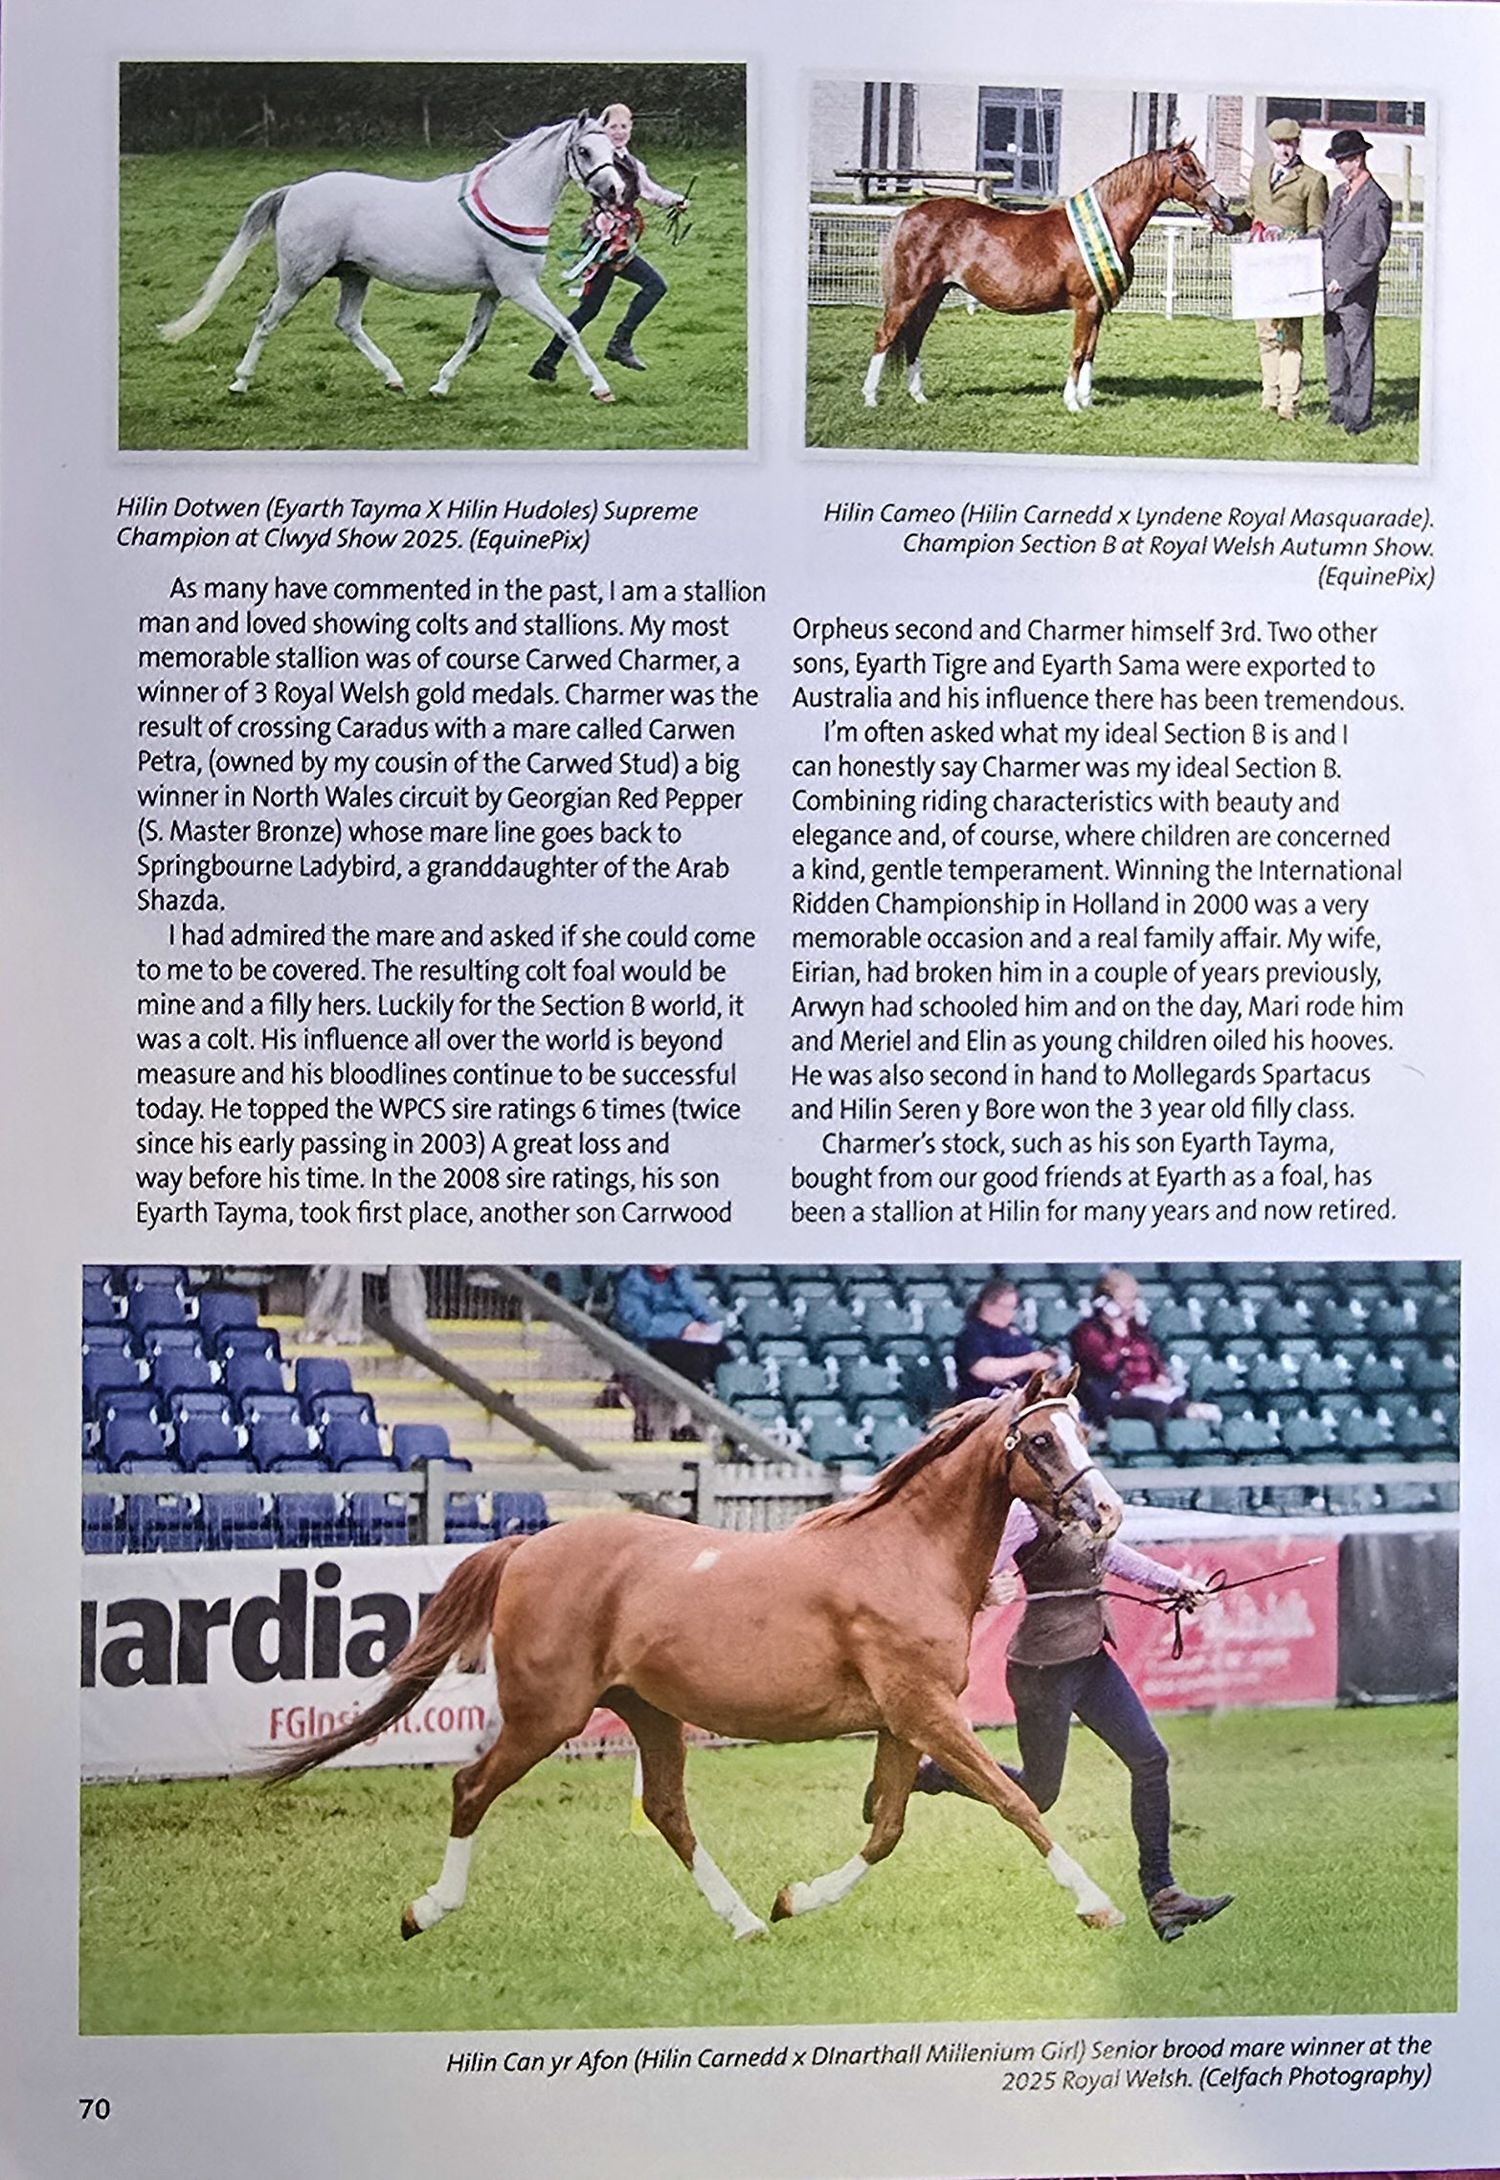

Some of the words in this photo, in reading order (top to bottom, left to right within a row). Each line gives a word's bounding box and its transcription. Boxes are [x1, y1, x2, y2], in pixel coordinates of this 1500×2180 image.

[117, 496, 168, 517] Hilin
[174, 497, 261, 518] Dotwen
[266, 496, 345, 525] (Eyarth
[351, 498, 422, 526] Tayma
[425, 499, 444, 520] X
[447, 499, 498, 520] Hilin
[503, 499, 599, 526] Hudoles)
[604, 500, 699, 527] Supreme
[824, 502, 874, 522] Hilin
[880, 503, 956, 524] Cameo
[961, 502, 1018, 528] (Hilin
[1024, 505, 1114, 525] Carnedd
[1117, 510, 1132, 525] x
[1136, 506, 1223, 532] Lyndene
[1228, 507, 1286, 534] Royal
[1290, 507, 1434, 533] Masquarade).
[117, 525, 230, 554] Champion
[235, 528, 260, 548] at
[264, 527, 333, 555] Clwyd
[337, 527, 399, 549] Show
[402, 529, 463, 550] 2025.
[470, 527, 591, 556] (EquinePix)
[904, 532, 1015, 559] Champion
[1020, 534, 1097, 555] Section
[1103, 535, 1117, 555] B
[1121, 536, 1145, 555] at
[1150, 535, 1209, 562] Royal
[1214, 536, 1275, 556] Welsh
[1280, 537, 1368, 557] Autumn
[1373, 537, 1434, 558] Show.
[169, 577, 198, 599] As
[204, 581, 269, 608] many
[275, 576, 328, 600] have
[334, 577, 471, 601] commented
[478, 578, 499, 601] in
[504, 578, 543, 602] the
[549, 580, 604, 609] past,
[610, 580, 615, 601] I
[622, 585, 658, 602] am
[664, 585, 677, 602] a
[684, 579, 766, 603] stallion
[1319, 564, 1435, 592] (EquinePix)
[793, 616, 889, 647] Orpheus
[895, 618, 973, 641] second
[979, 618, 1021, 641] and
[1028, 618, 1126, 642] Charmer
[1132, 619, 1216, 643] himself
[1221, 620, 1262, 643] 3rd.
[1267, 621, 1313, 644] Two
[1318, 621, 1378, 644] other
[139, 714, 203, 739] result
[208, 714, 235, 738] of
[237, 715, 332, 747] crossing
[337, 715, 429, 740] Caradus
[435, 716, 487, 740] with
[493, 722, 506, 740] a
[513, 722, 571, 740] mare
[576, 716, 643, 741] called
[649, 718, 735, 741] Carwen
[137, 783, 219, 808] winner
[225, 784, 246, 808] in
[253, 784, 319, 808] North
[325, 784, 394, 809] Wales
[399, 785, 470, 809] circuit
[476, 785, 503, 817] by
[507, 786, 611, 817] Georgian
[618, 786, 659, 810] Red
[666, 787, 744, 817] Pepper
[792, 788, 917, 820] Combining
[923, 789, 988, 820] riding
[993, 789, 1153, 813] characteristics
[1159, 790, 1209, 813] with
[1217, 790, 1293, 821] beauty
[1299, 790, 1339, 813] and
[137, 853, 294, 885] Springbourne
[300, 853, 403, 885] Ladybird,
[408, 860, 421, 878] a
[427, 854, 599, 886] granddaughter
[604, 854, 629, 879] of
[632, 855, 671, 879] the
[676, 856, 730, 879] Arab
[792, 863, 805, 880] a
[812, 857, 866, 884] kind,
[871, 857, 943, 888] gentle
[948, 859, 1110, 888] temperament.
[1115, 858, 1211, 888] Winning
[1216, 858, 1253, 881] the
[1260, 859, 1402, 882] International
[137, 887, 225, 912] Shazda.
[137, 1067, 236, 1085] measure
[242, 1061, 284, 1086] and
[292, 1061, 324, 1086] his
[331, 1061, 448, 1086] bloodlines
[453, 1062, 554, 1086] continue
[559, 1064, 583, 1086] to
[589, 1062, 617, 1086] be
[622, 1062, 736, 1086] successful
[792, 1065, 823, 1087] He
[828, 1069, 873, 1087] was
[879, 1063, 924, 1087] also
[930, 1063, 1007, 1087] second
[1015, 1063, 1034, 1086] in
[1041, 1062, 1097, 1086] hand
[1104, 1064, 1127, 1086] to
[1133, 1062, 1257, 1093] Mollegards
[1263, 1063, 1371, 1092] Spartacus
[137, 1200, 208, 1231] Eyarth
[214, 1201, 294, 1231] Tayma,
[299, 1200, 351, 1224] took
[356, 1200, 403, 1224] first
[409, 1200, 474, 1231] place,
[480, 1200, 571, 1224] another
[576, 1206, 616, 1224] son
[622, 1200, 732, 1224] Carrwood
[792, 1200, 846, 1223] been
[852, 1206, 865, 1223] a
[871, 1200, 953, 1223] stallion
[960, 1201, 983, 1223] at
[989, 1200, 1040, 1222] Hilin
[1046, 1198, 1078, 1222] for
[1084, 1205, 1147, 1229] many
[1151, 1204, 1210, 1229] years
[1216, 1198, 1257, 1221] and
[1265, 1204, 1313, 1221] now
[1319, 1198, 1396, 1221] retired.
[80, 1561, 486, 1688] ardia
[447, 2052, 498, 2073] Hilin
[504, 2052, 545, 2072] Can
[547, 2055, 574, 2078] yr
[576, 2049, 628, 2078] Afon
[634, 2048, 692, 2075] (Hilin
[698, 2046, 789, 2069] Carnedd
[792, 2051, 807, 2067] x
[926, 2042, 1035, 2064] Millenium
[1041, 2039, 1086, 2065] Girl)
[1092, 2040, 1159, 2060] Senior
[1163, 2038, 1226, 2060] brood
[1229, 2042, 1286, 2058] mare
[1291, 2036, 1366, 2057] winner
[1369, 2036, 1393, 2056] at
[1398, 2035, 1433, 2056] the
[1002, 2071, 1057, 2091] 2025
[1063, 2069, 1121, 2096] Royal
[1126, 2068, 1193, 2089] Welsh.
[1199, 2066, 1283, 2094] (Celfach
[1289, 2062, 1433, 2092] Photography)
[79, 2097, 111, 2120] 70
